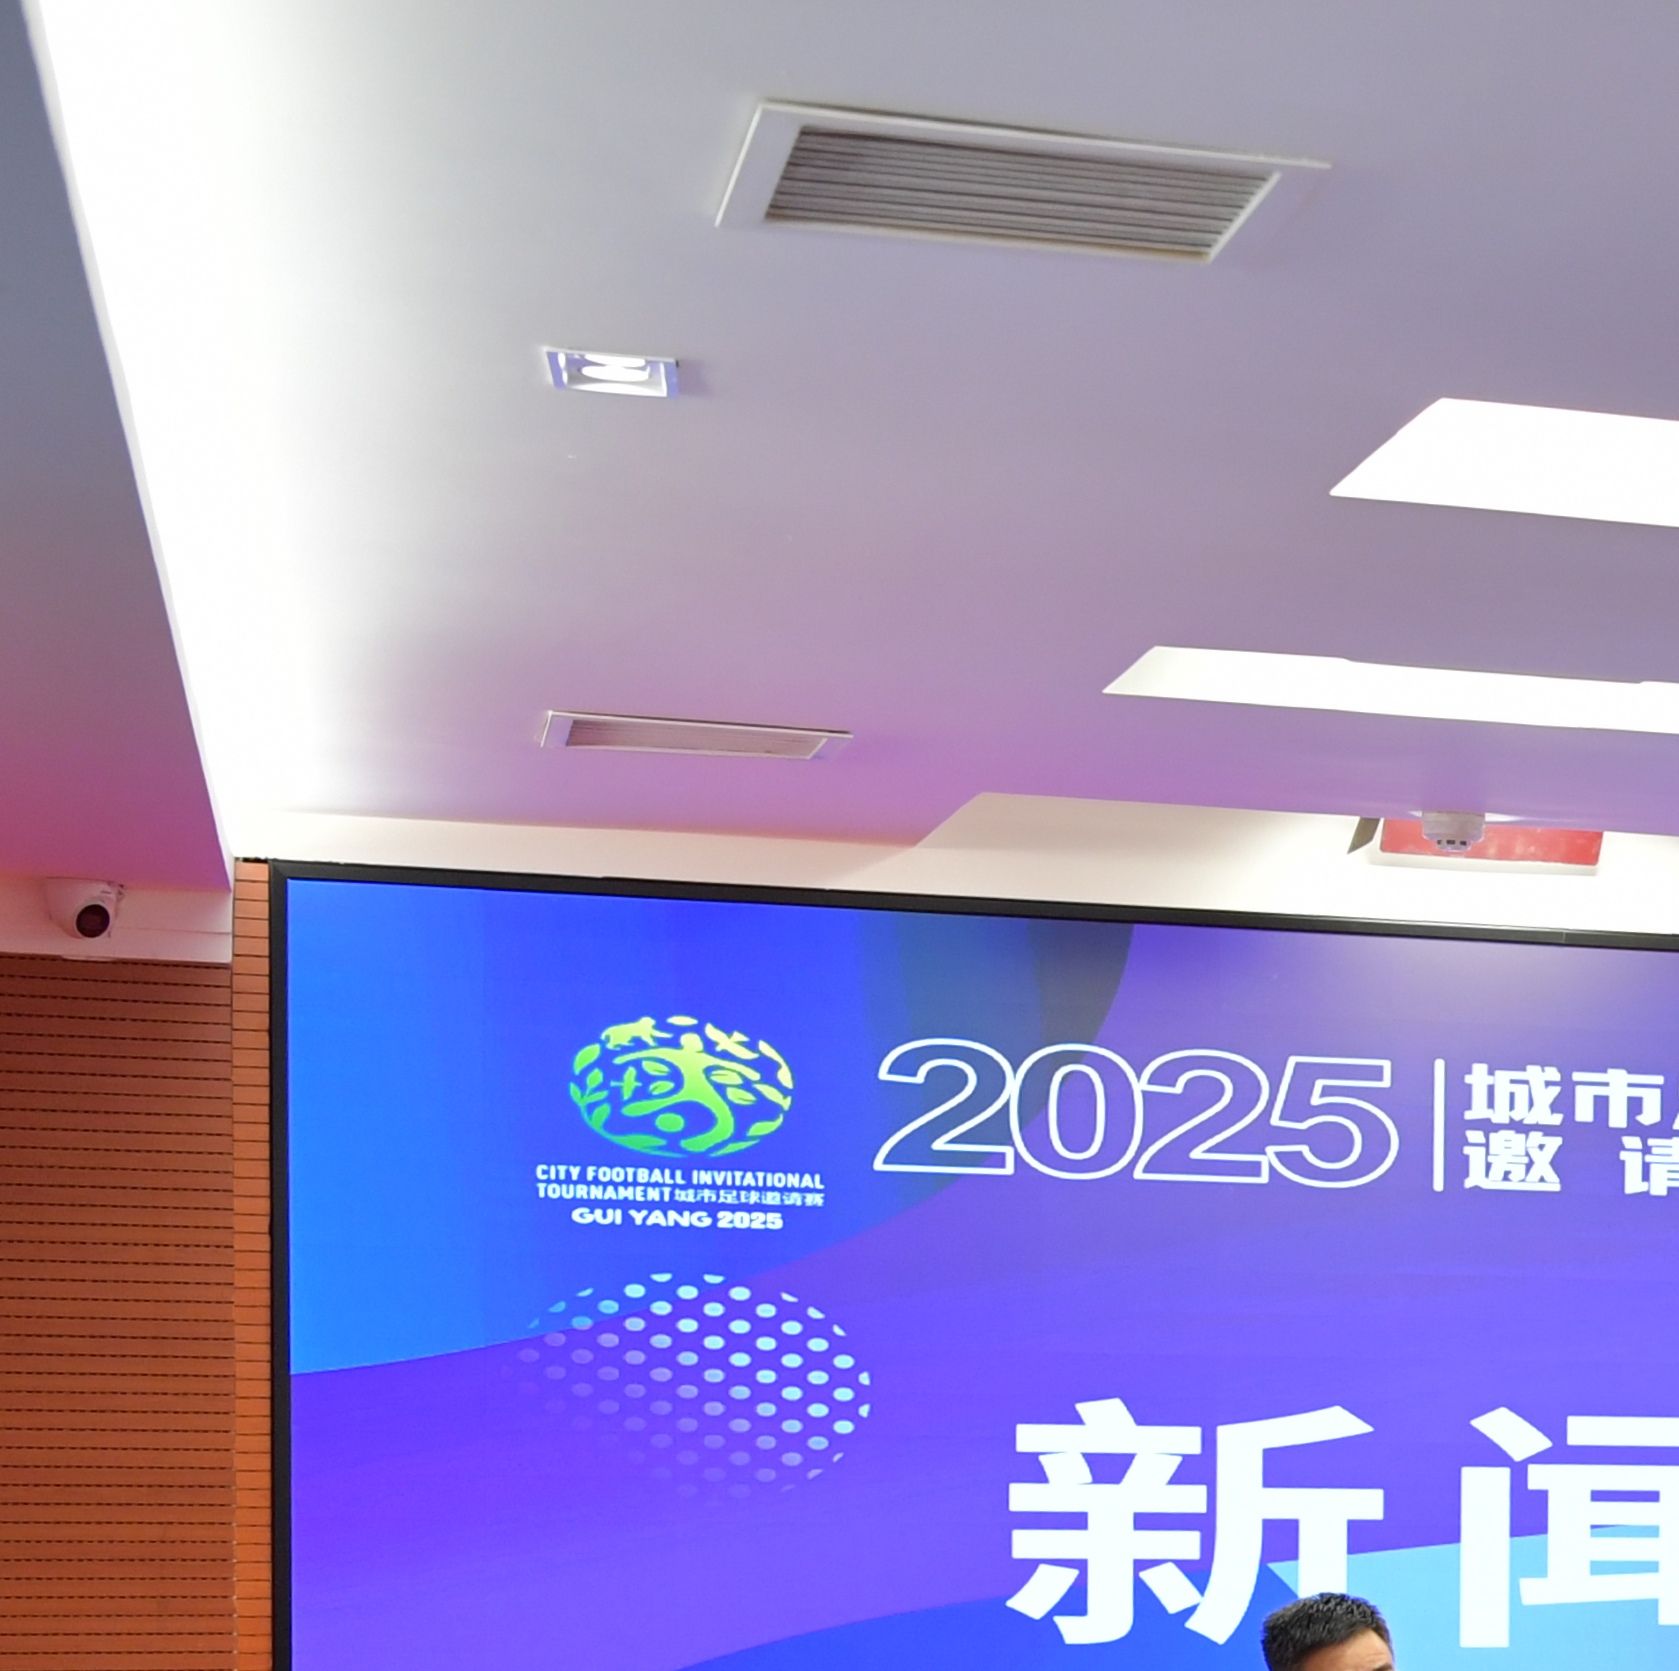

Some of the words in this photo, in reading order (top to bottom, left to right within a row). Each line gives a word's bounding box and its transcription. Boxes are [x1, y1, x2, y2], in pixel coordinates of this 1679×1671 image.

[872, 1037, 1400, 1189] 2025
[535, 1164, 581, 1181] CITY
[586, 1166, 686, 1185] FOOTBALL
[692, 1169, 825, 1190] INVITATIONAL
[536, 1182, 672, 1202] TOURNAMENT
[571, 1207, 622, 1225] GUI
[628, 1209, 713, 1228] YANG
[716, 1211, 784, 1230] 2025
